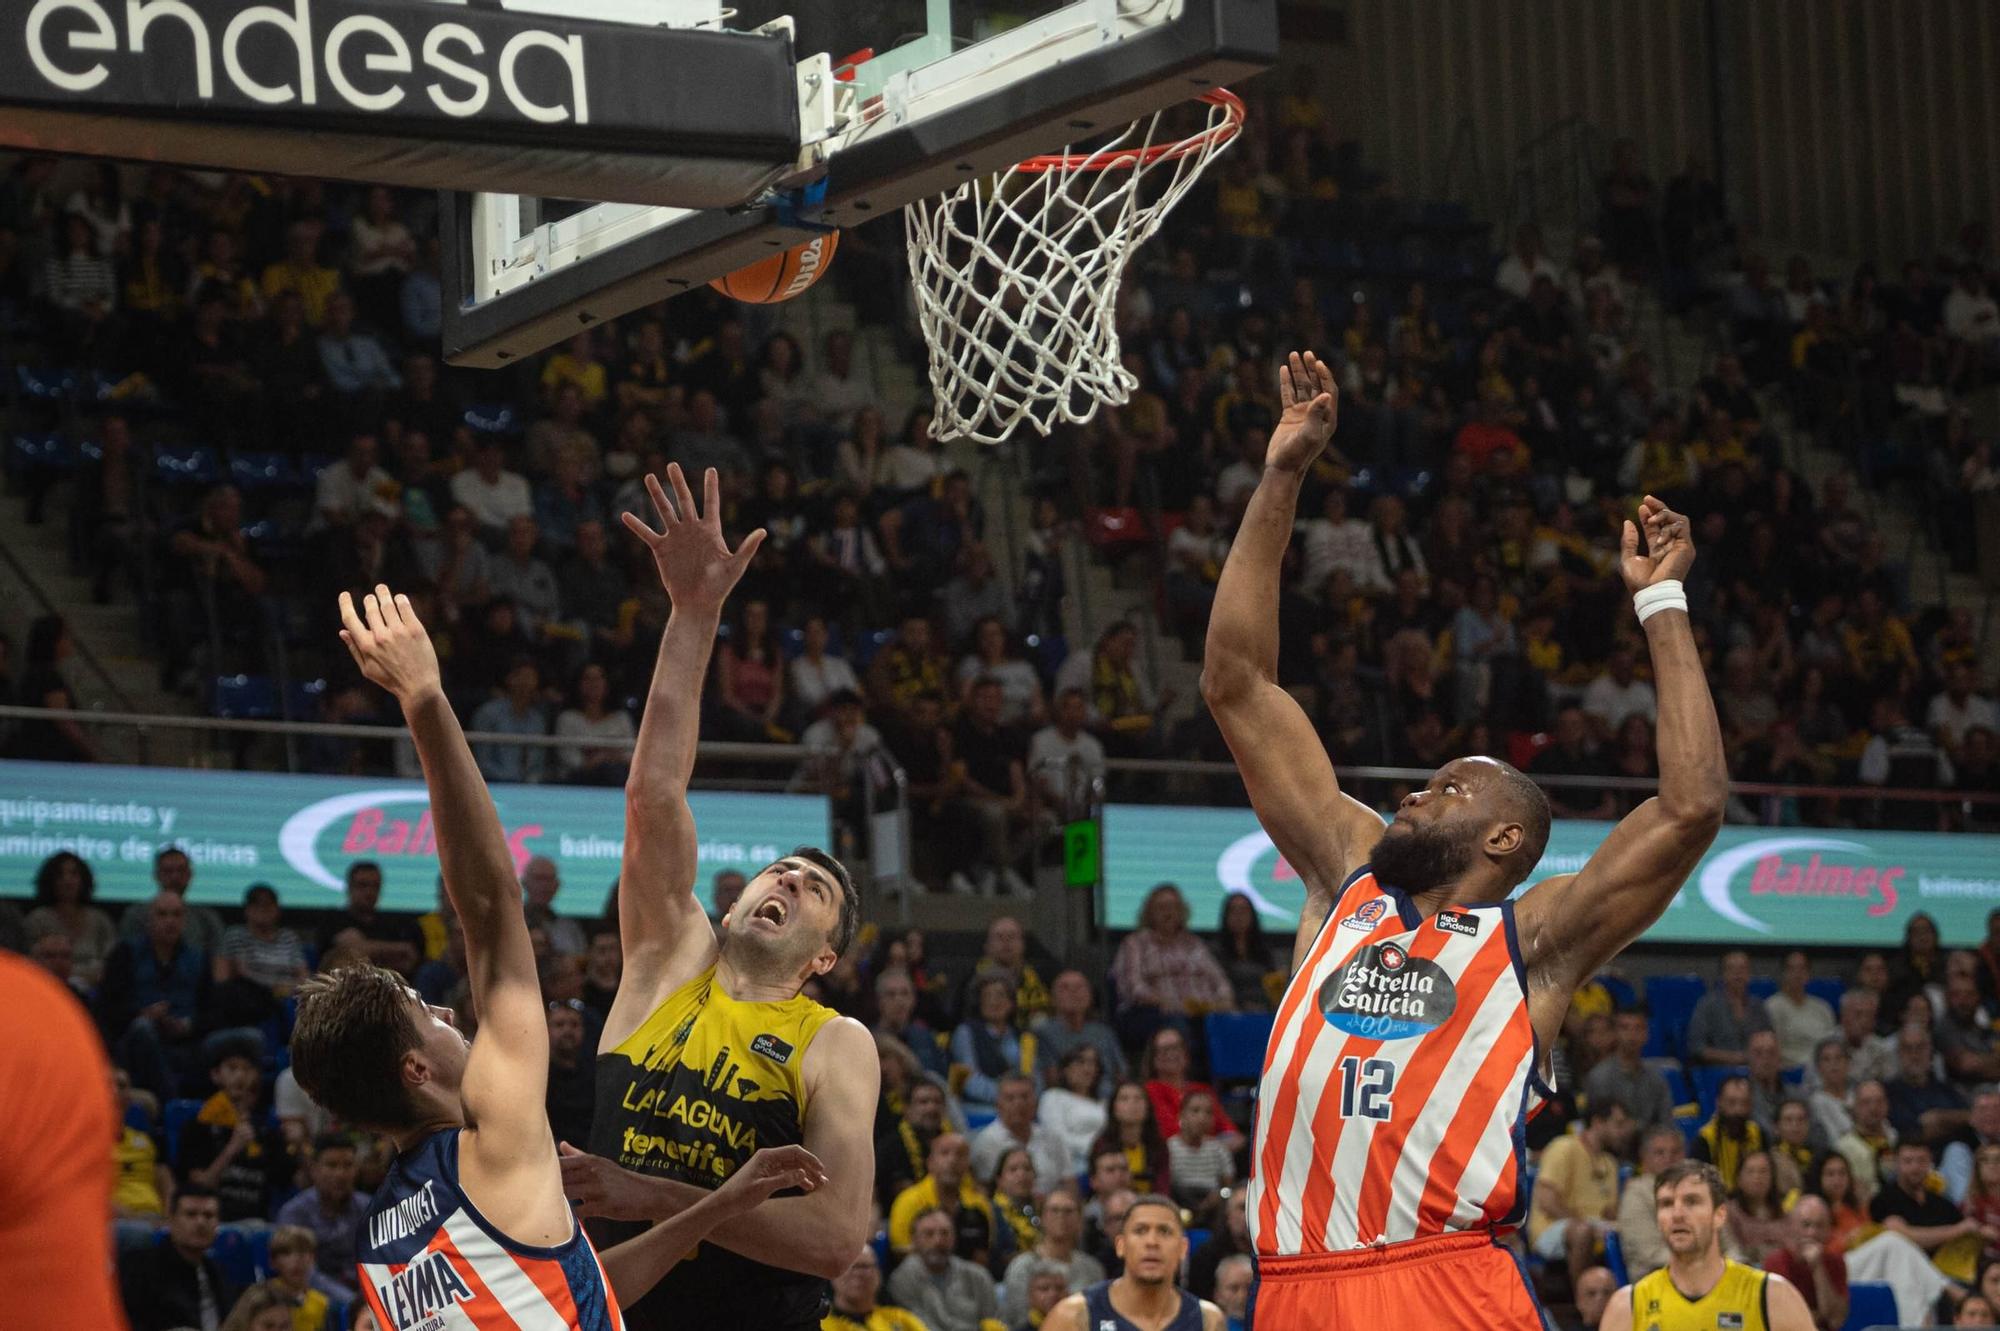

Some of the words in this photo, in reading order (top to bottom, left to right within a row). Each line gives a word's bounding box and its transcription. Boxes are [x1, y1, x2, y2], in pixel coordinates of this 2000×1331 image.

[25, 0, 589, 124] endesa
[158, 806, 177, 834] y
[120, 835, 150, 862] de
[1750, 852, 1905, 917] Balmes
[1439, 921, 1476, 934] endesa
[1343, 961, 1434, 994] Estrella
[1338, 984, 1425, 1017] Galicia
[754, 1043, 786, 1062] endesa
[1338, 1056, 1397, 1122] 12
[623, 1126, 735, 1177] tenerife
[369, 1179, 439, 1250] LUNDQUIST
[380, 1253, 471, 1331] LEYMA
